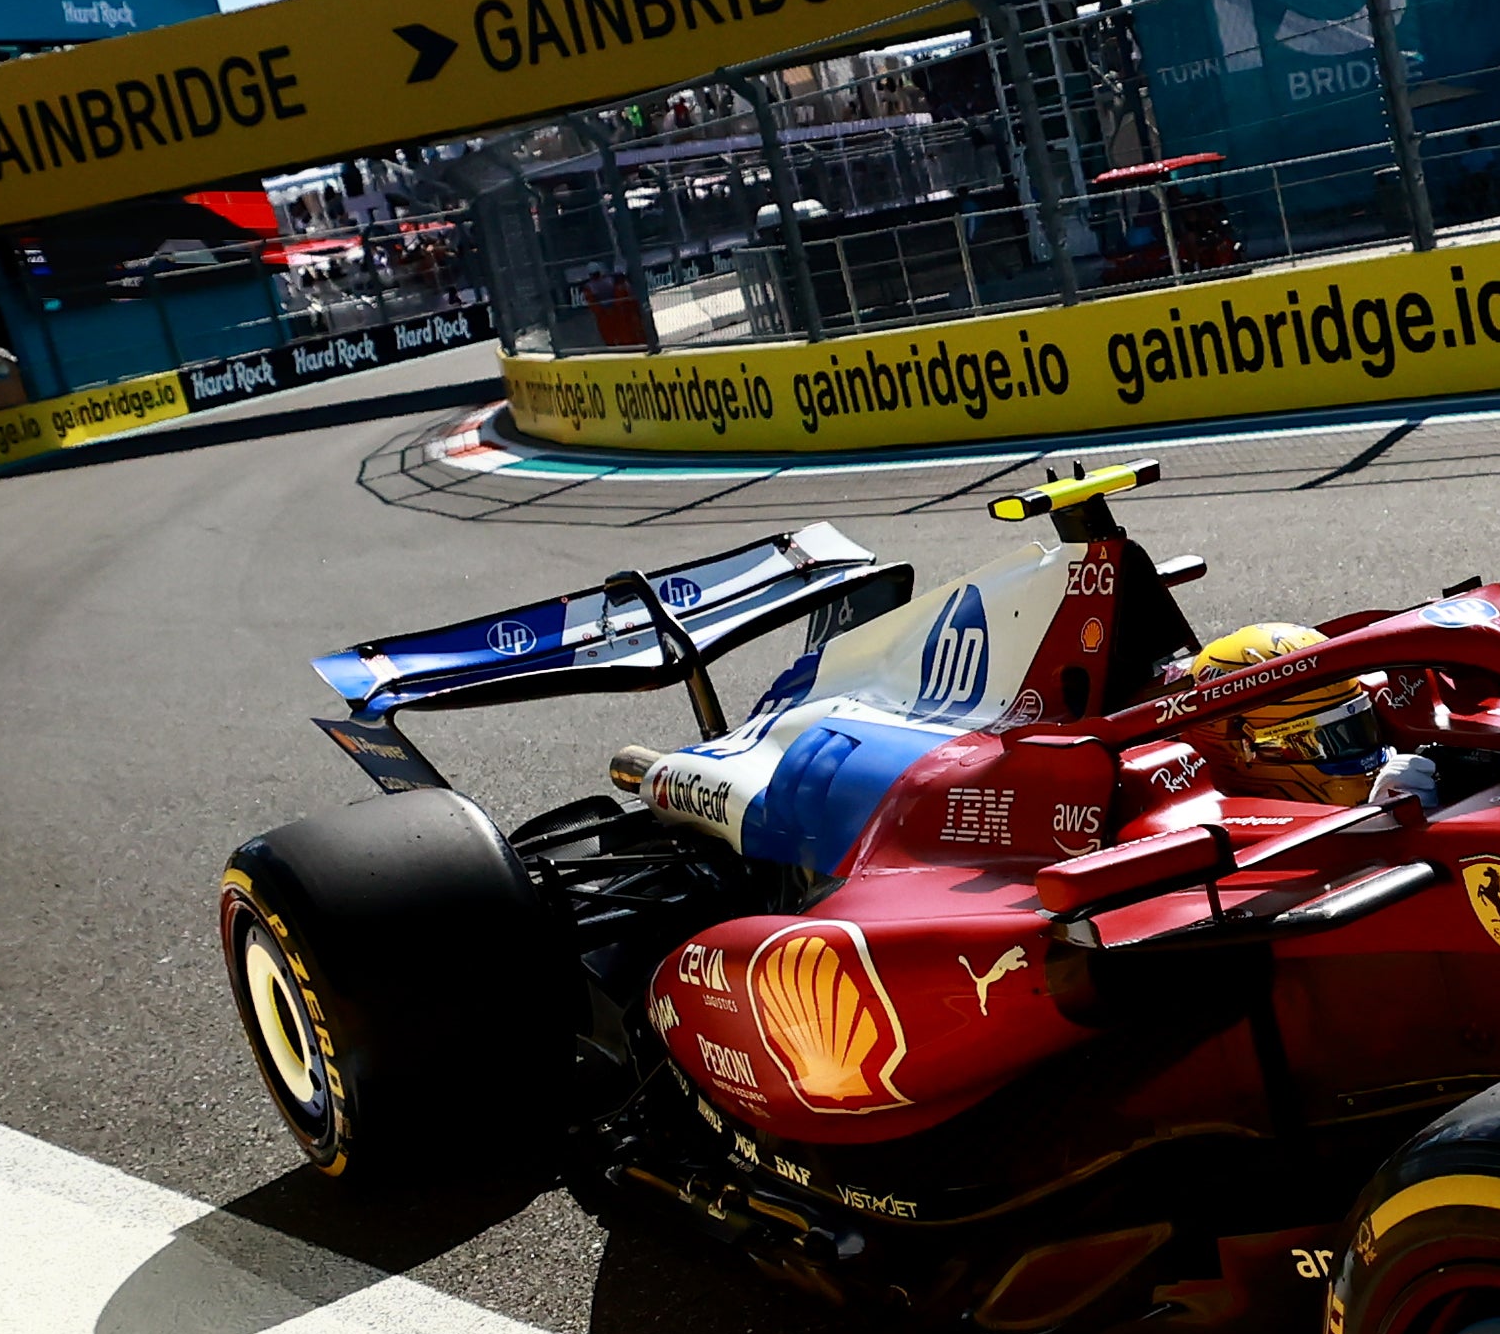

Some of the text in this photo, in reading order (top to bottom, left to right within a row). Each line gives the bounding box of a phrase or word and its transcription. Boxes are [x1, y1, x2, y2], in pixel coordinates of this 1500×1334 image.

[62, 0, 136, 28] Hard Rock
[1157, 57, 1222, 86] TURN
[1288, 51, 1425, 101] BRIDE
[394, 317, 434, 351] Hard
[434, 311, 473, 339] Rock
[292, 332, 379, 375] Hard Rock
[189, 357, 277, 401] Hard Rock
[614, 362, 773, 435] gainbridge.io
[793, 329, 1070, 435] gainbridge.io
[51, 373, 177, 439] gainbridge.io
[662, 577, 698, 608] hp
[1067, 562, 1115, 596] ZCG
[494, 621, 530, 655] hp
[915, 584, 987, 724] hp
[1156, 690, 1198, 724] DXC
[1202, 656, 1321, 702] TECHNOLOGY
[668, 770, 733, 826] UniCredit
[940, 787, 1015, 845] IBM
[1053, 801, 1100, 834] aws
[266, 913, 290, 940] P
[285, 949, 347, 1102] ZERO
[703, 994, 739, 1013] LOGISTICS
[697, 1033, 759, 1088] PERONI
[734, 1129, 760, 1166] NGK
[774, 1155, 812, 1187] SKF
